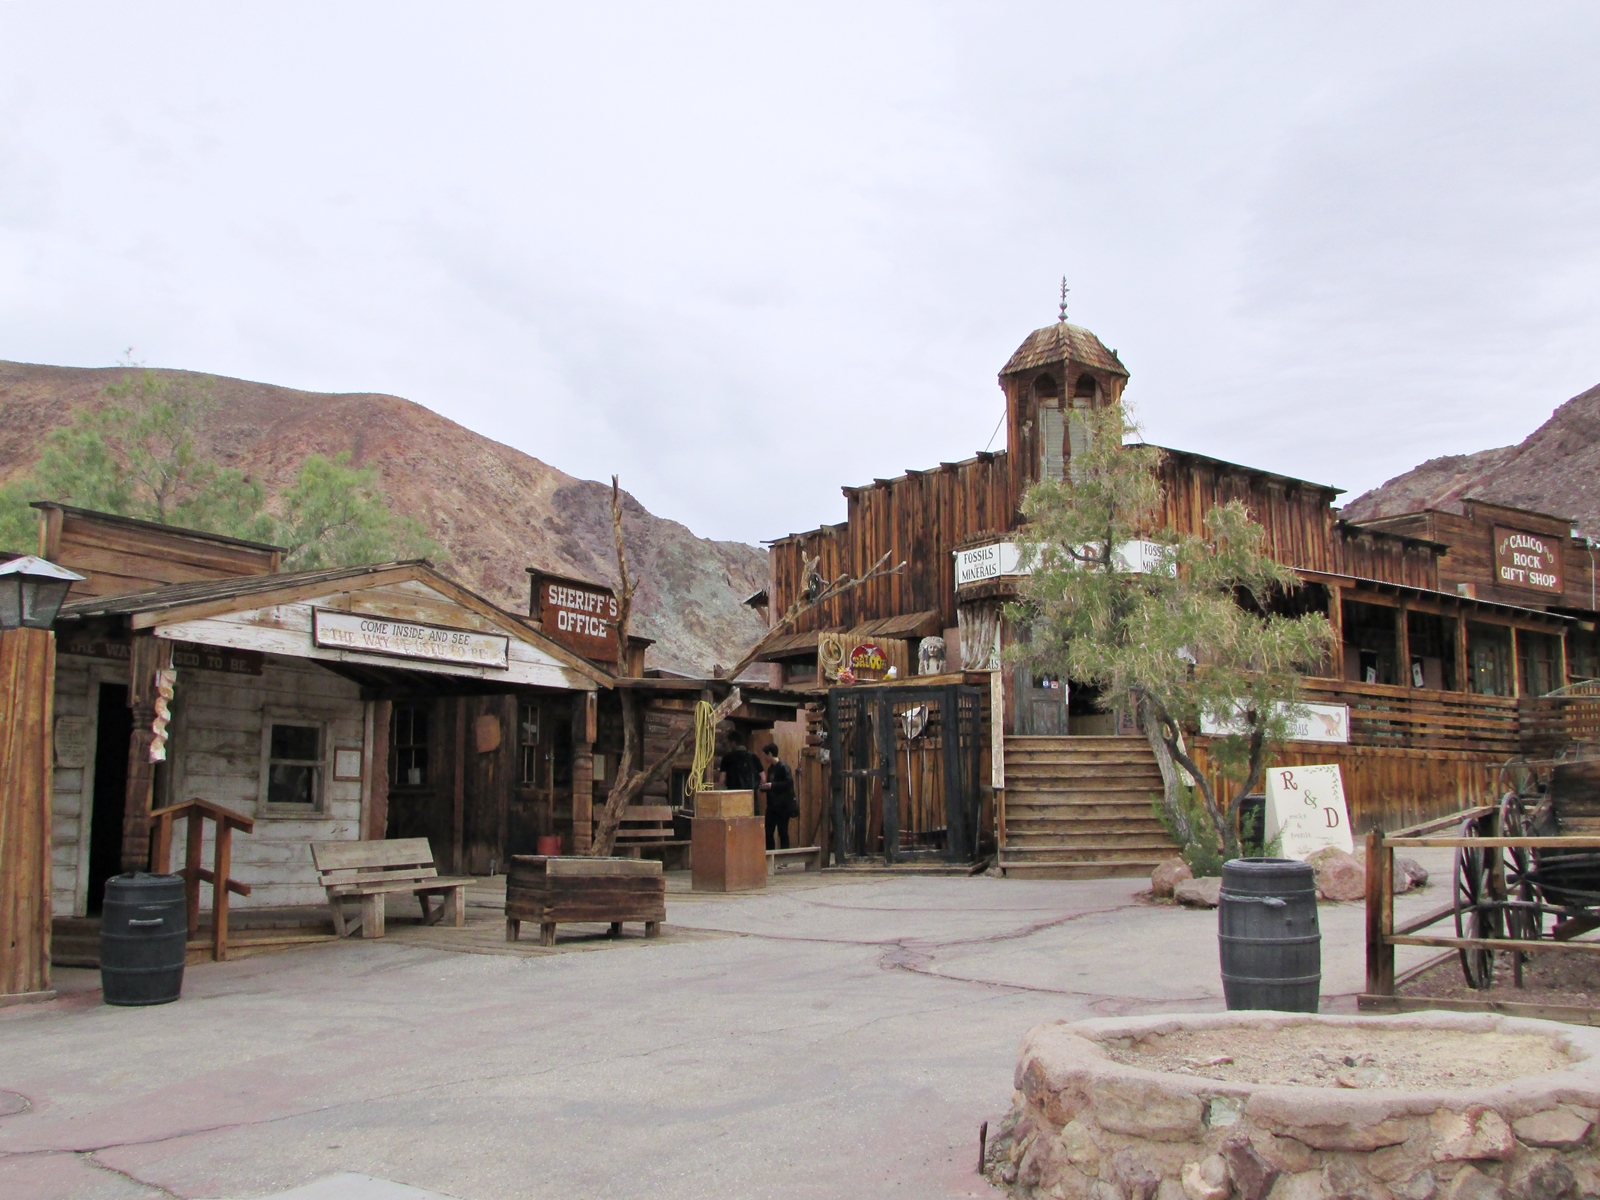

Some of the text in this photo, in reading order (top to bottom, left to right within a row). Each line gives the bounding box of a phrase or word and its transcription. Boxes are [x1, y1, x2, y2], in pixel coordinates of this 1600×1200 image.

[1509, 535, 1542, 553] CALICO
[963, 547, 993, 564] FOSSILS
[1513, 552, 1541, 569] ROCK
[962, 563, 997, 581] MINERALS
[1501, 566, 1556, 587] GIFT SHOP
[548, 584, 618, 617] SHERIFF'S
[360, 620, 470, 646] COME INSIDE AND SEE
[557, 610, 607, 638] OFFICE
[332, 628, 354, 644] THE
[362, 633, 390, 649] WAY
[207, 655, 223, 669] TO
[1280, 770, 1298, 790] R
[1303, 789, 1317, 809] &
[1323, 806, 1340, 829] D
